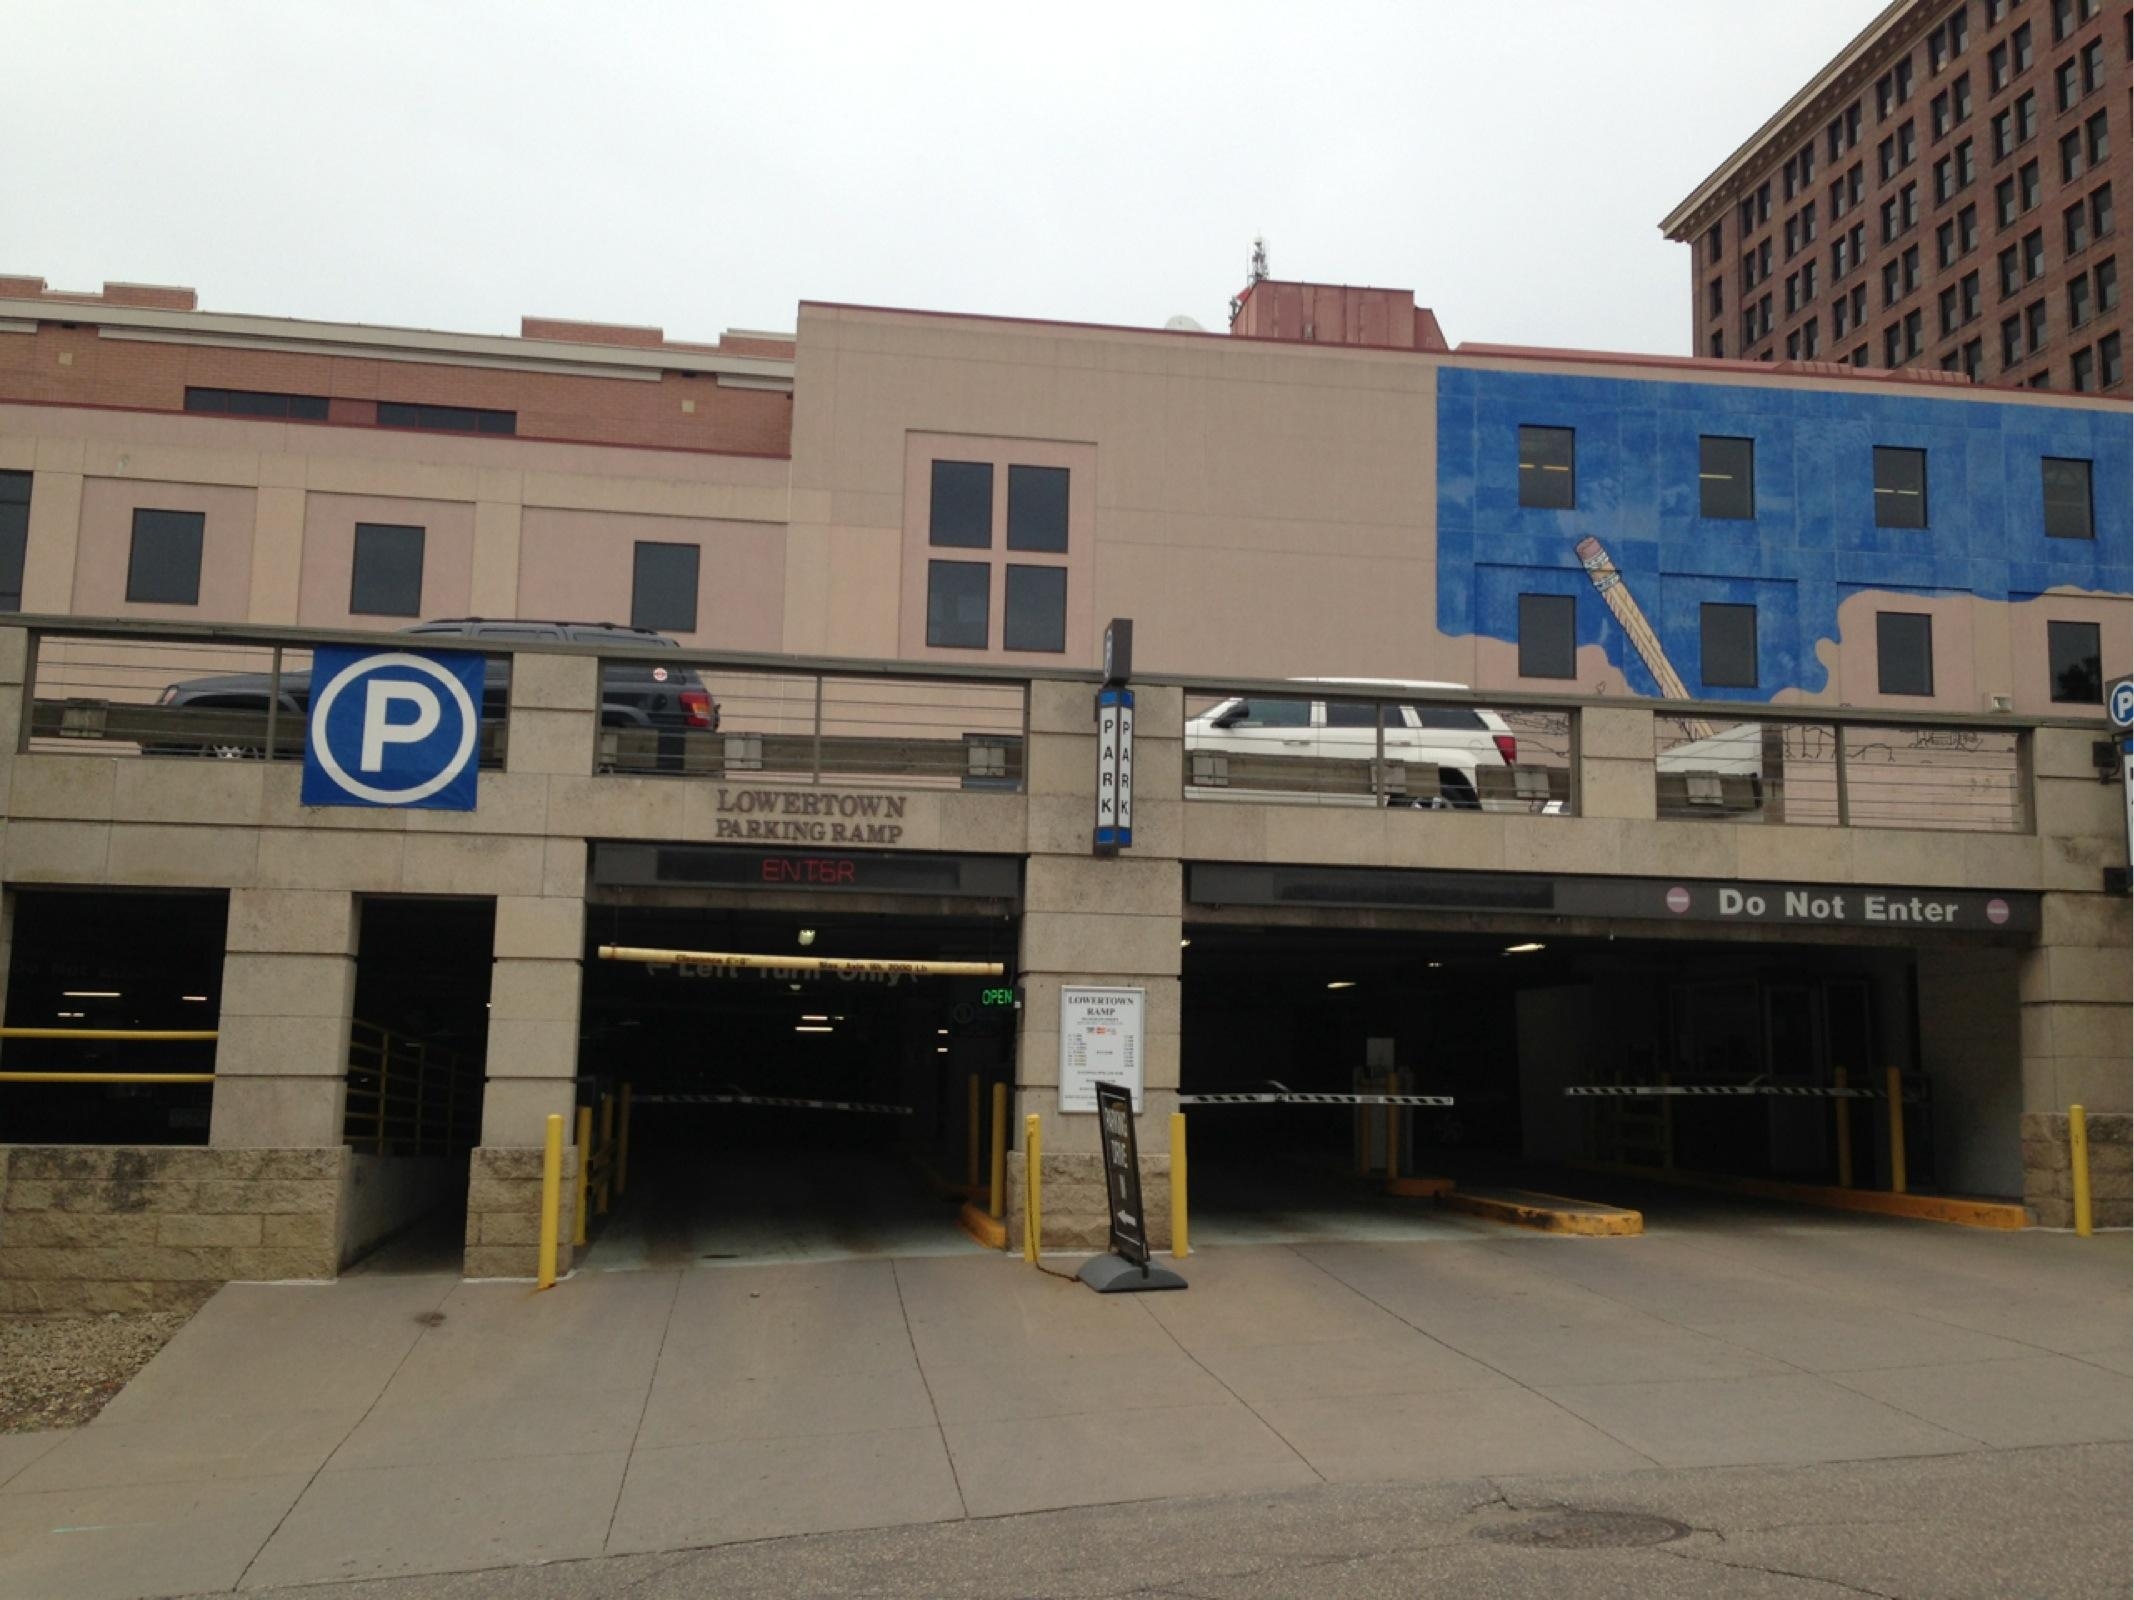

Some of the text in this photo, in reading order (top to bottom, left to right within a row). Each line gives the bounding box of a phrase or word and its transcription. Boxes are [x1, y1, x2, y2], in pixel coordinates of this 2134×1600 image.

[361, 679, 441, 773] P
[1101, 719, 1114, 813] PARK
[1121, 721, 1131, 815] PARK
[716, 789, 907, 818] LOWERTOWN
[715, 818, 904, 844] PARKING RAMP
[1718, 888, 1959, 922] Do Not Enter
[981, 988, 1013, 1006] OPEN
[1067, 995, 1134, 1005] LOWERTOWN
[1086, 1007, 1116, 1016] RAMP
